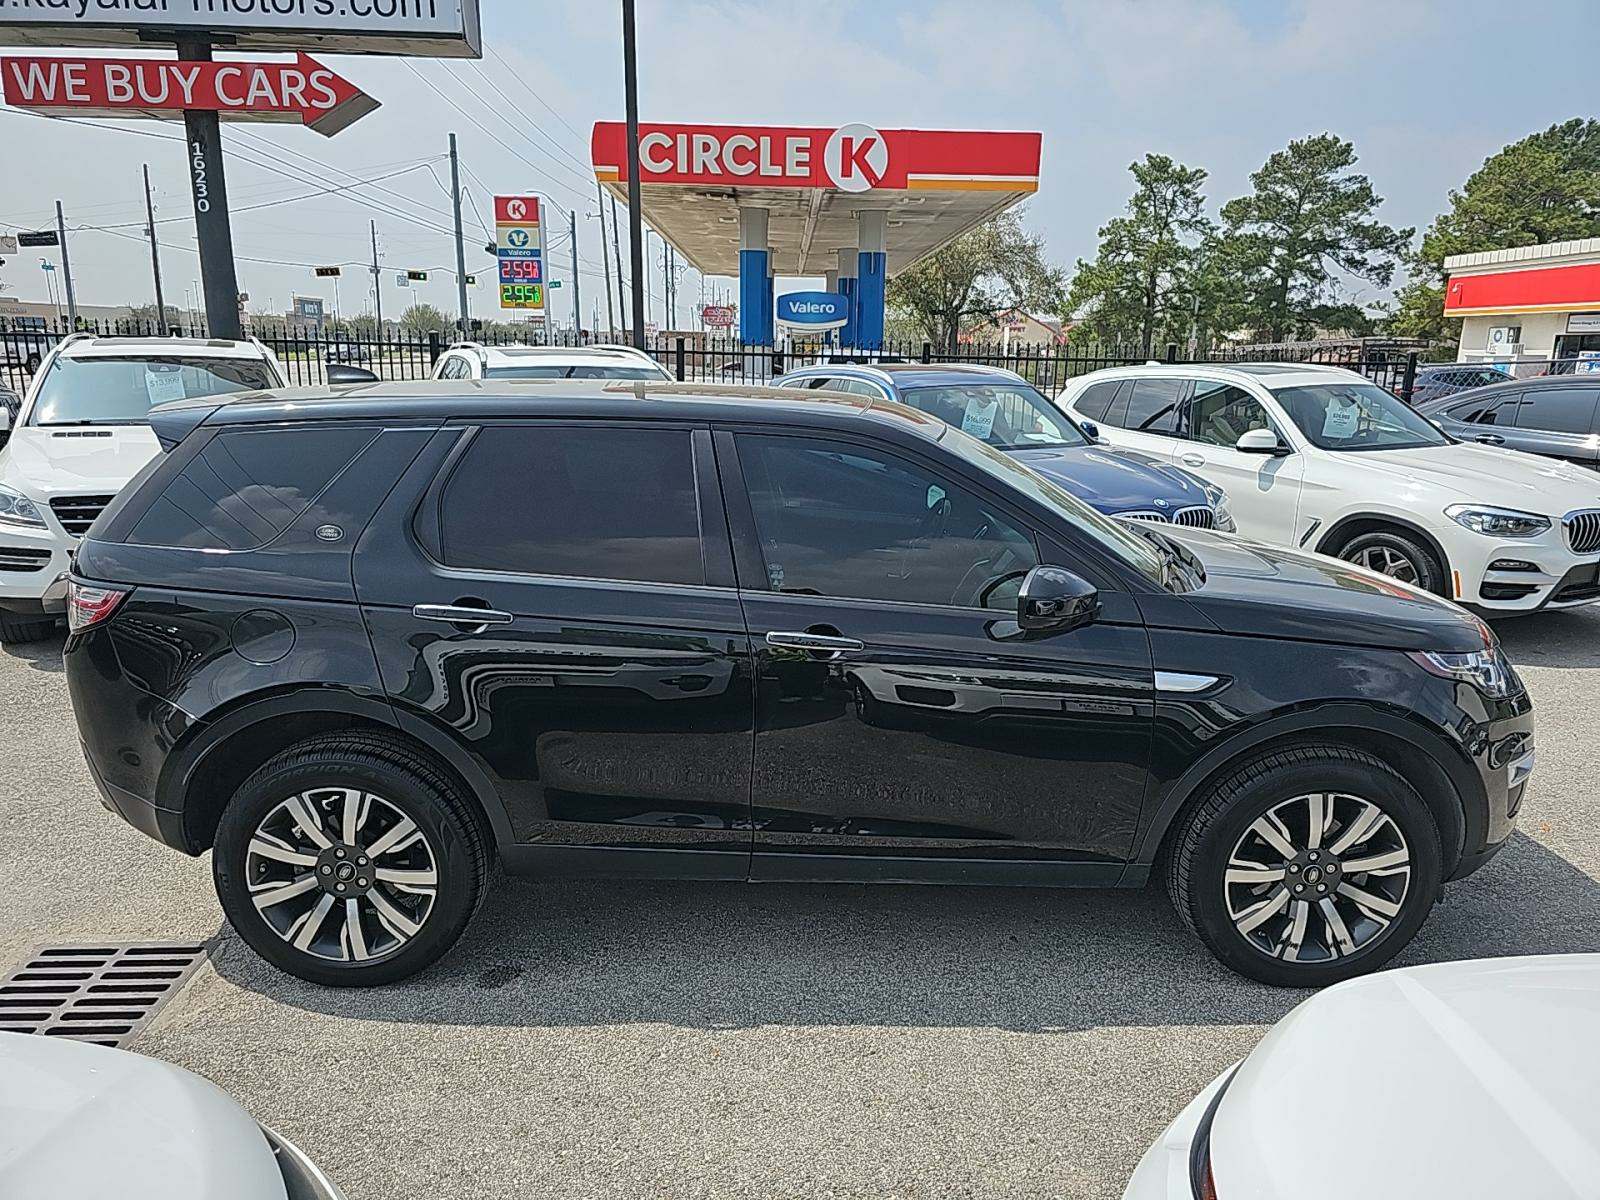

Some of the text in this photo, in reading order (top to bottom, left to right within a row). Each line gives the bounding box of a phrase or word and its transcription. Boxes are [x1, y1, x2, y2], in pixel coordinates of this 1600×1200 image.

[11, 62, 337, 110] WE BUY CARS
[192, 142, 210, 212] 16230
[638, 132, 882, 188] CIRCLE K
[512, 204, 525, 216] K
[789, 301, 835, 314] Valero
